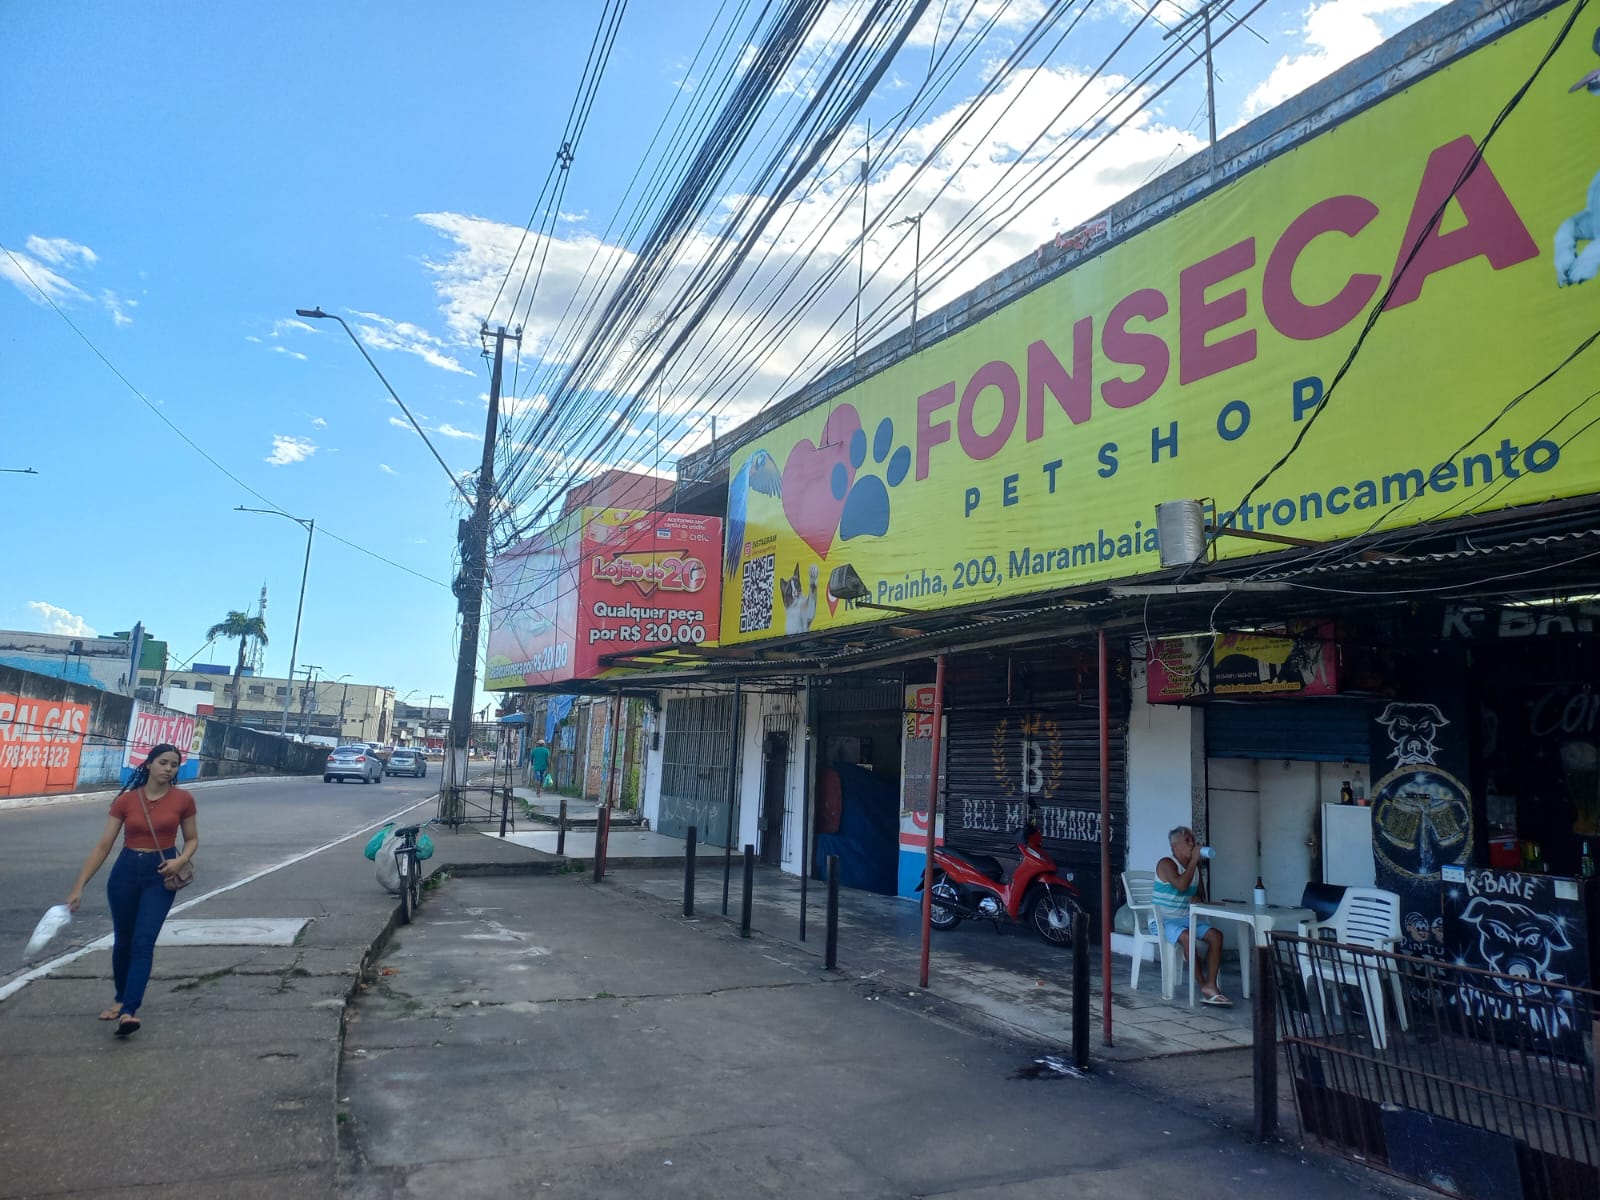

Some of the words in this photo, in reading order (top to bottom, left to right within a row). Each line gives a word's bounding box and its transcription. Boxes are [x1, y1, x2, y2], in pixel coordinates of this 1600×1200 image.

[916, 134, 1539, 481] FONSECA
[877, 568, 948, 605] Prainha,
[952, 555, 1003, 590] 200,
[1008, 520, 1160, 577] Marambaia
[1202, 437, 1561, 541] Entroncamento
[593, 556, 644, 583] Lojão
[661, 557, 706, 592] 20
[593, 601, 666, 623] Qualquer
[667, 609, 704, 624] peça
[589, 628, 617, 645] por
[619, 625, 641, 642] R$
[644, 623, 706, 643] 20,00
[543, 642, 568, 671] 20,00
